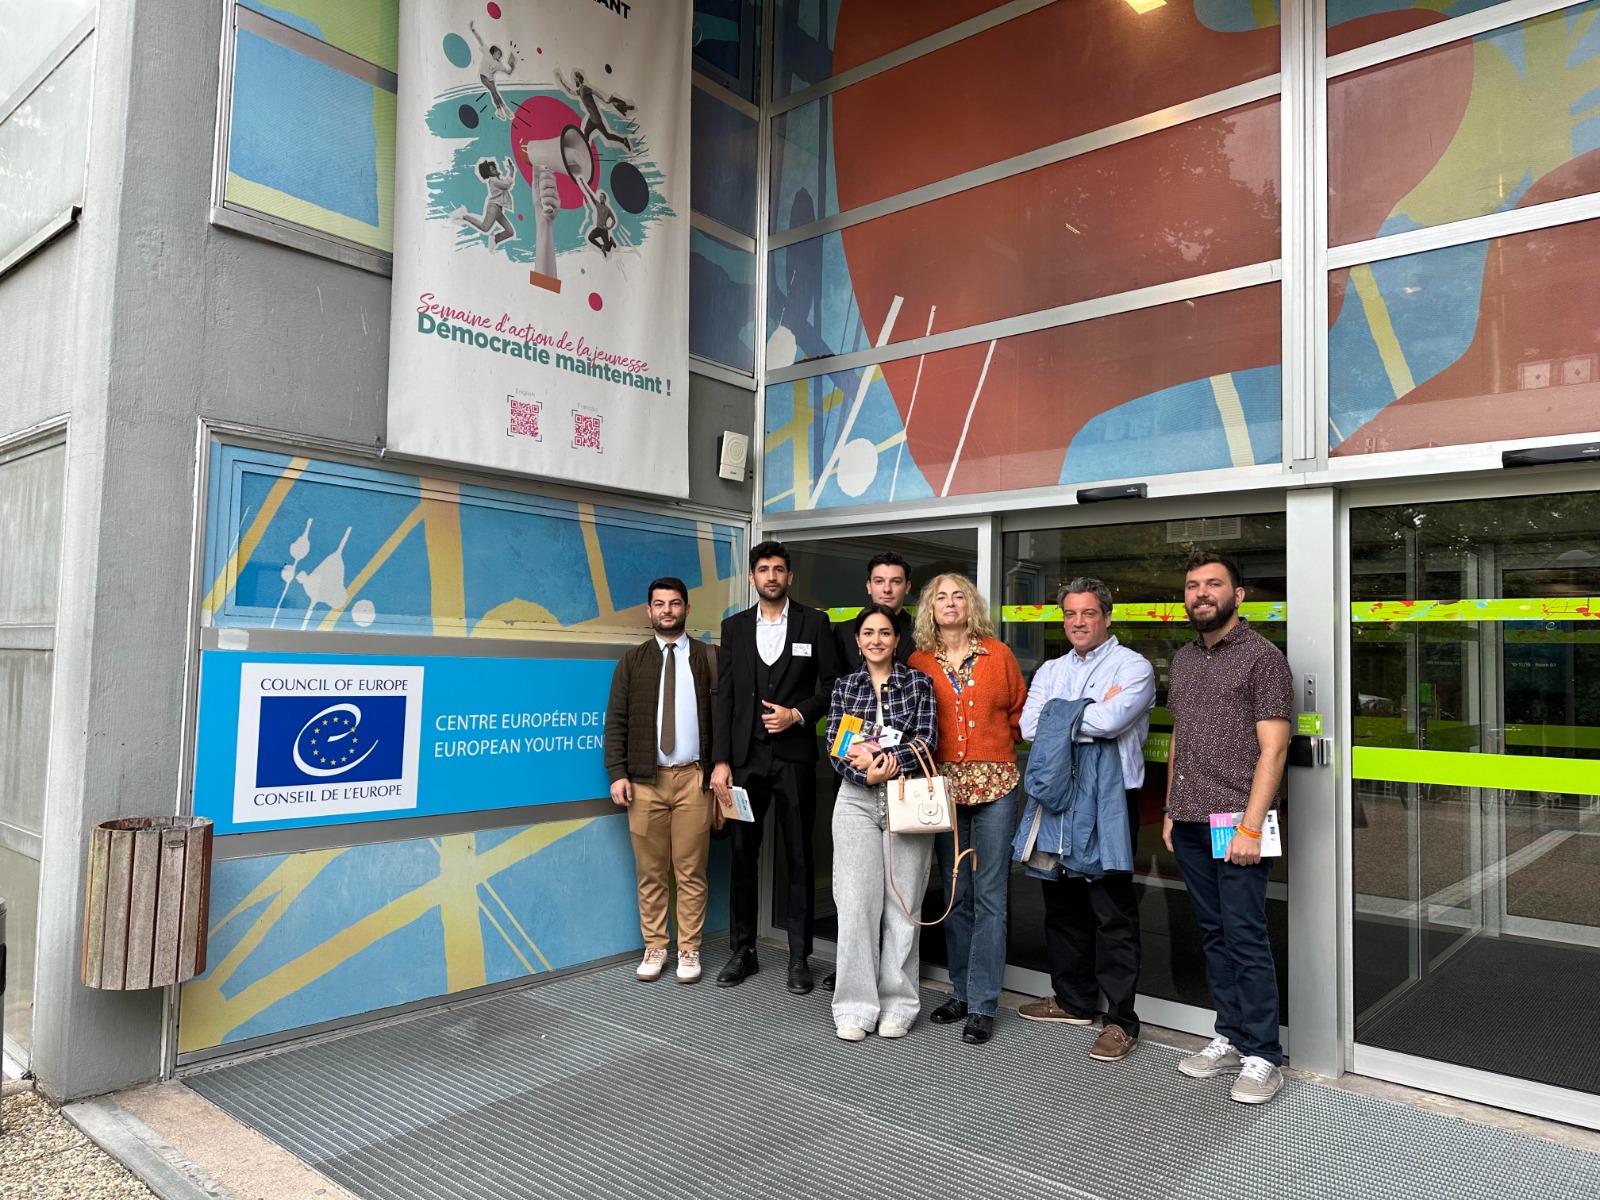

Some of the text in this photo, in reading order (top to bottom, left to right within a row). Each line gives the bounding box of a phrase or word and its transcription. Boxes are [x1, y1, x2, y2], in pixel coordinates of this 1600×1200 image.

[416, 292, 649, 373] Semaine d'action de la jeunesse
[417, 312, 551, 365] Démocratie
[555, 352, 662, 395] maintenant
[260, 678, 409, 691] COUNCIL OF EUROPE
[435, 714, 498, 731] CENTRE
[502, 710, 577, 729] EUROPÉEN
[581, 712, 599, 726] DE
[434, 734, 605, 758] EUROPEAN YOUTH CEN
[253, 784, 403, 806] CONSEIL DE L'EUROPE
